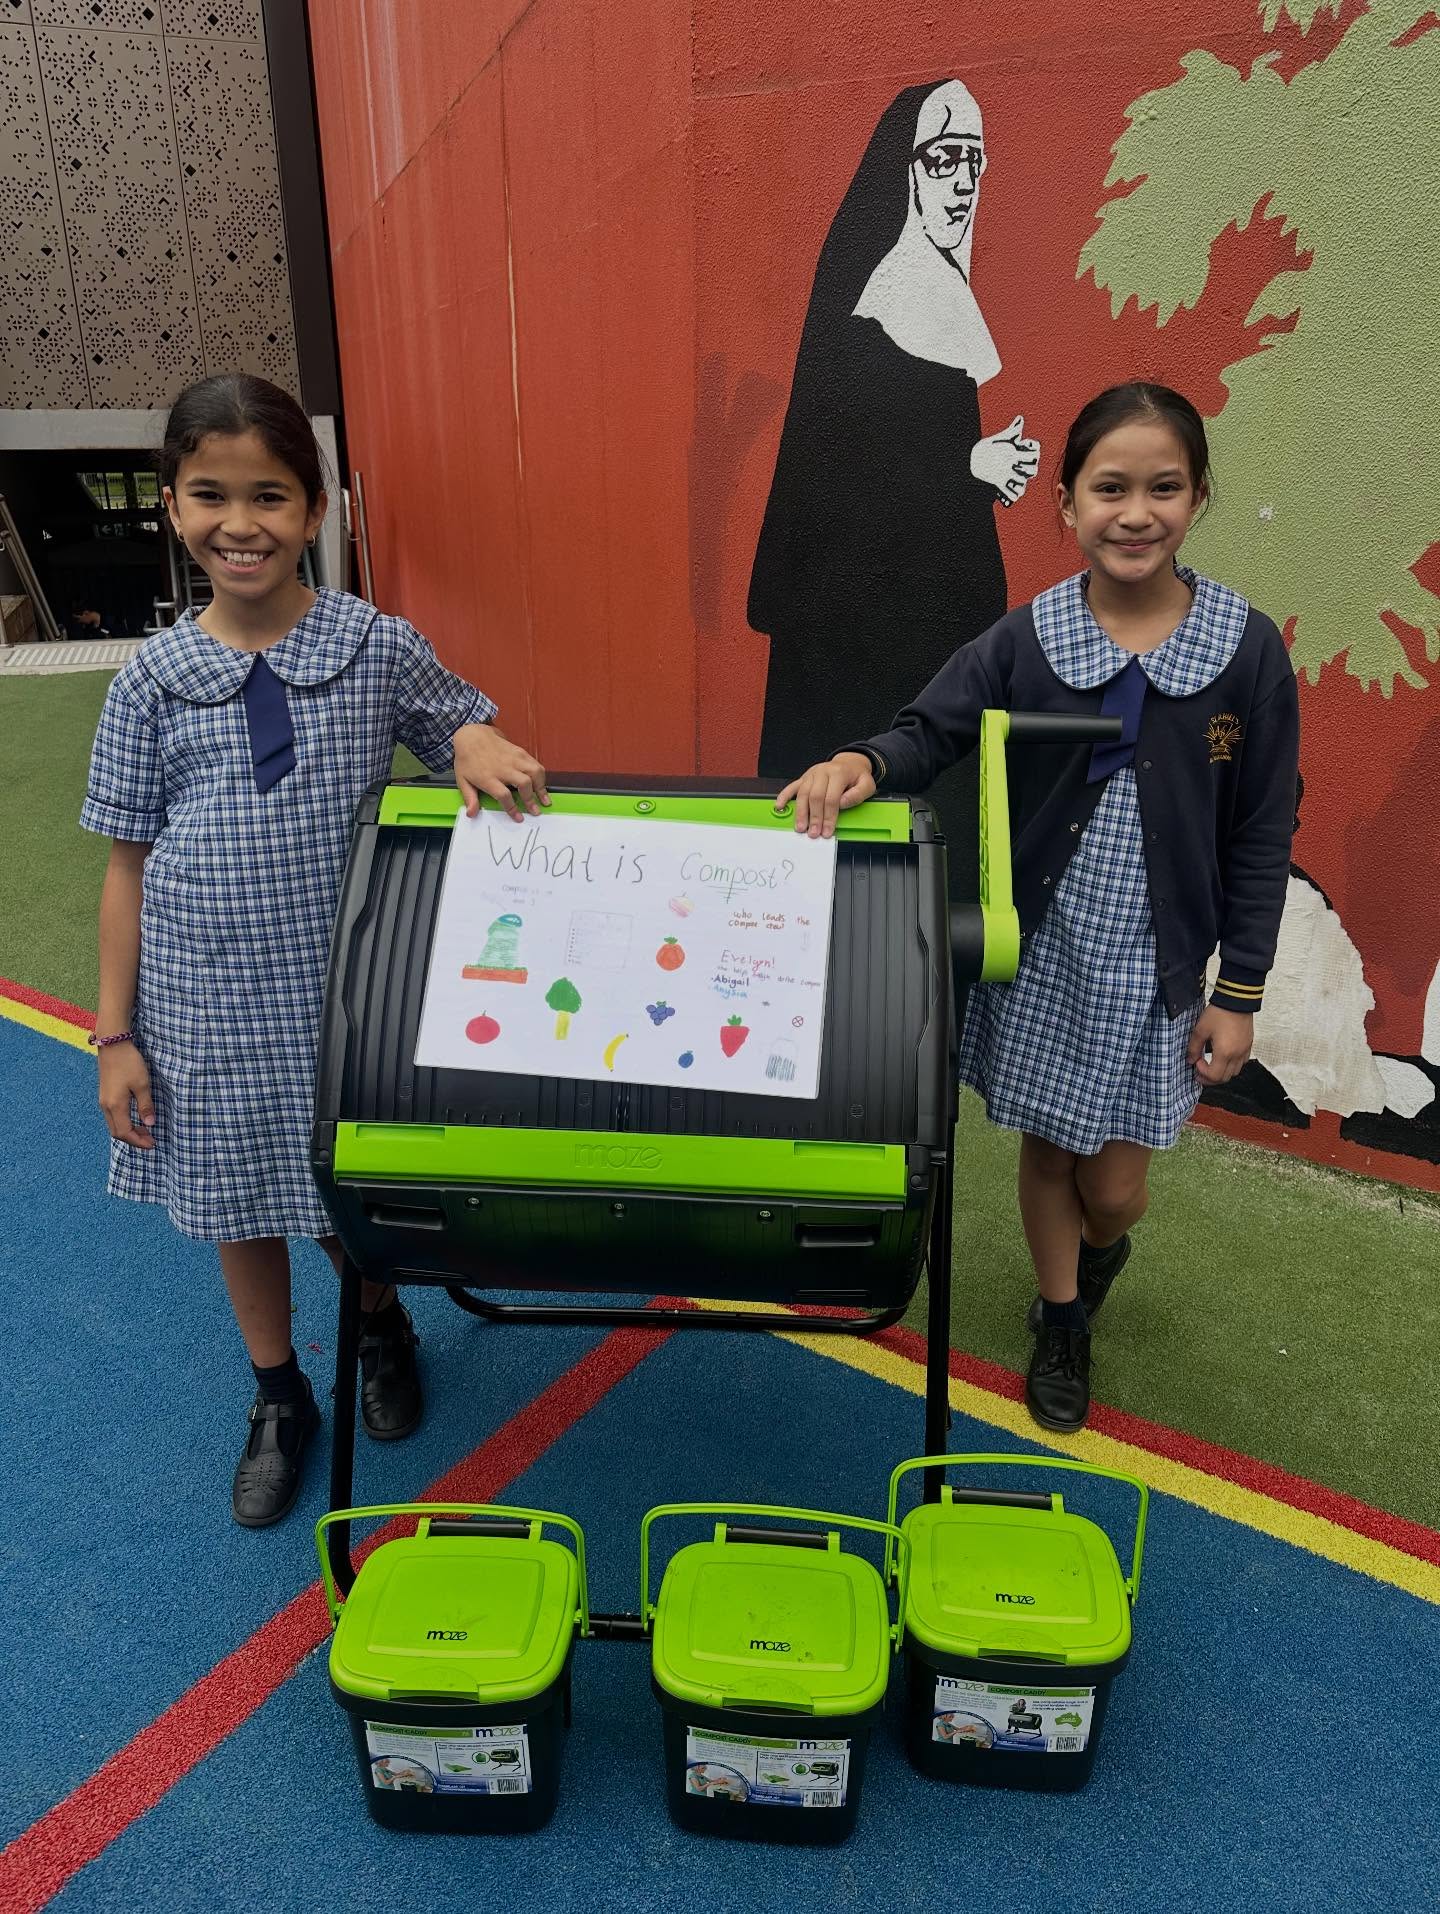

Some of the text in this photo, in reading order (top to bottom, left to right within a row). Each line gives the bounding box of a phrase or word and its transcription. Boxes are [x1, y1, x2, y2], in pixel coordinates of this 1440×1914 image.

[488, 826, 795, 904] What is Compost?
[797, 916, 811, 926] the
[574, 1143, 663, 1170] maze
[995, 1592, 1036, 1605] maze
[426, 1629, 468, 1641] maze
[750, 1639, 792, 1652] maze
[941, 1678, 985, 1692] maze
[990, 1686, 1022, 1695] COMPOST
[372, 1724, 404, 1736] COMPOST
[476, 1727, 521, 1738] maze
[695, 1731, 727, 1742] COMPOST
[728, 1736, 752, 1744] CADDY
[800, 1740, 845, 1751] maze
